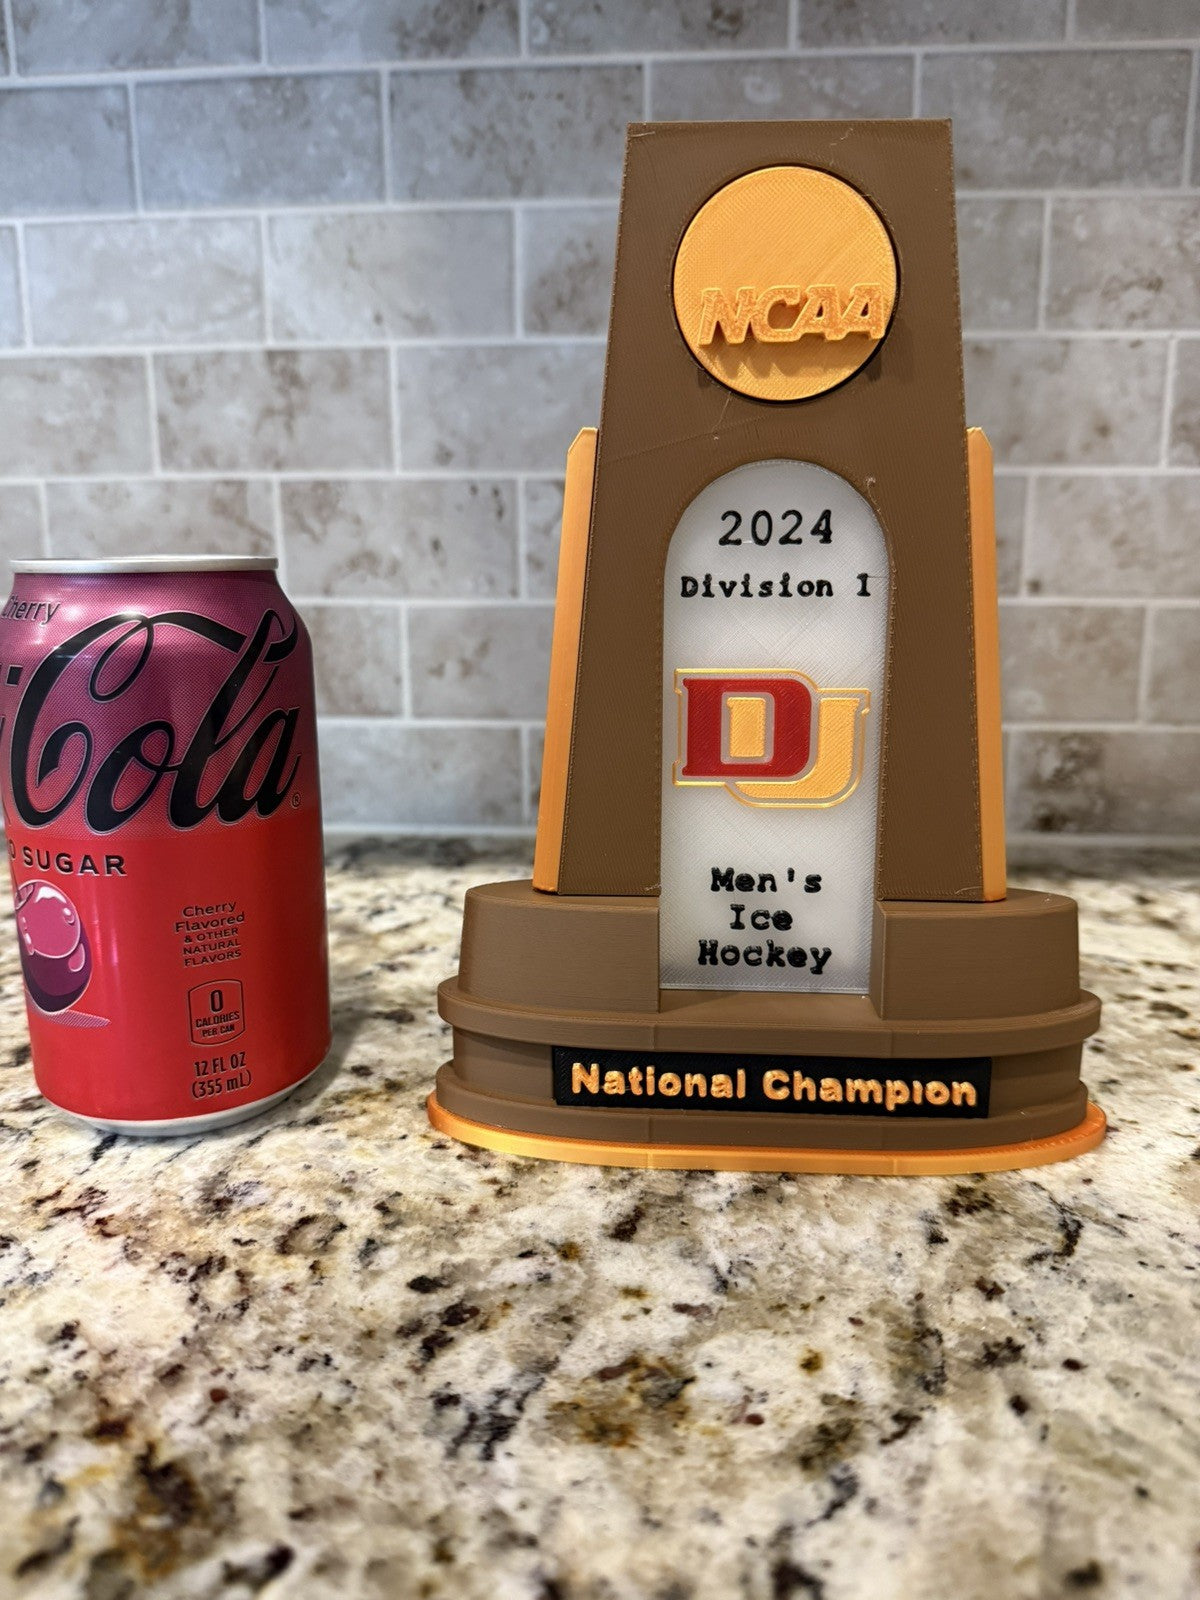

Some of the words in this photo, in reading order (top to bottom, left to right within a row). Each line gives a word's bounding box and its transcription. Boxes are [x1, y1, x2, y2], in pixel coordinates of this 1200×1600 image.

[699, 283, 886, 345] NCAA
[718, 508, 833, 546] 2024
[680, 573, 834, 598] Division
[10, 608, 302, 835] Cola
[22, 845, 127, 876] SUGAR
[710, 867, 822, 893] Men's
[174, 912, 246, 933] Flavored
[182, 901, 237, 918] Cherry
[729, 903, 793, 930] Ice
[182, 940, 241, 955] NATURAL
[196, 927, 239, 942] OTHER
[183, 950, 242, 968] FLAVORS
[697, 939, 832, 974] Hockey
[210, 989, 224, 1013] 0
[195, 1011, 240, 1029] CALORIES
[201, 1026, 217, 1038] PER
[220, 1024, 235, 1036] CAN
[193, 1060, 208, 1078] 12
[212, 1057, 226, 1074] FL
[230, 1051, 246, 1069] OZ
[191, 1076, 222, 1099] (355
[226, 1069, 252, 1092] mL)
[571, 1062, 746, 1099] National
[762, 1069, 977, 1111] Champion
